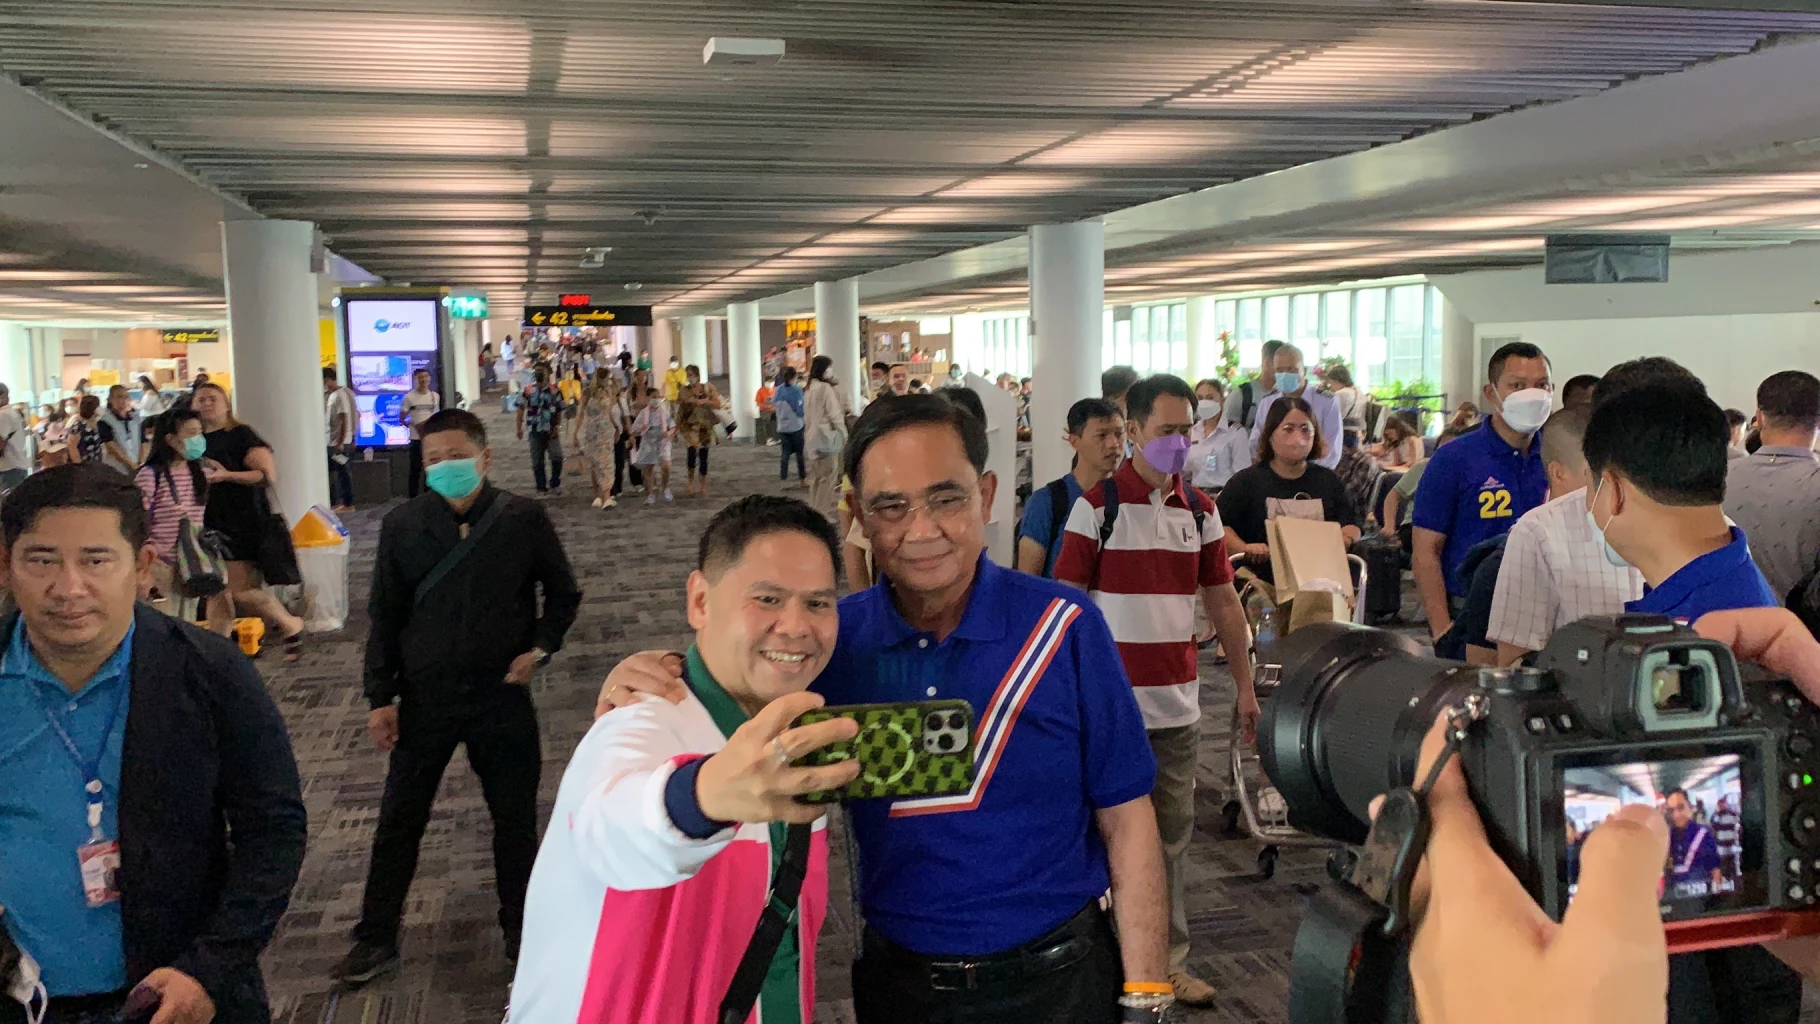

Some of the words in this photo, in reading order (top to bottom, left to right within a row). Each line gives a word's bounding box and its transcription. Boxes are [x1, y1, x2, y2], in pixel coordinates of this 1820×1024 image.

[549, 311, 568, 325] 42
[174, 332, 188, 342] 42
[1478, 489, 1513, 519] 22
